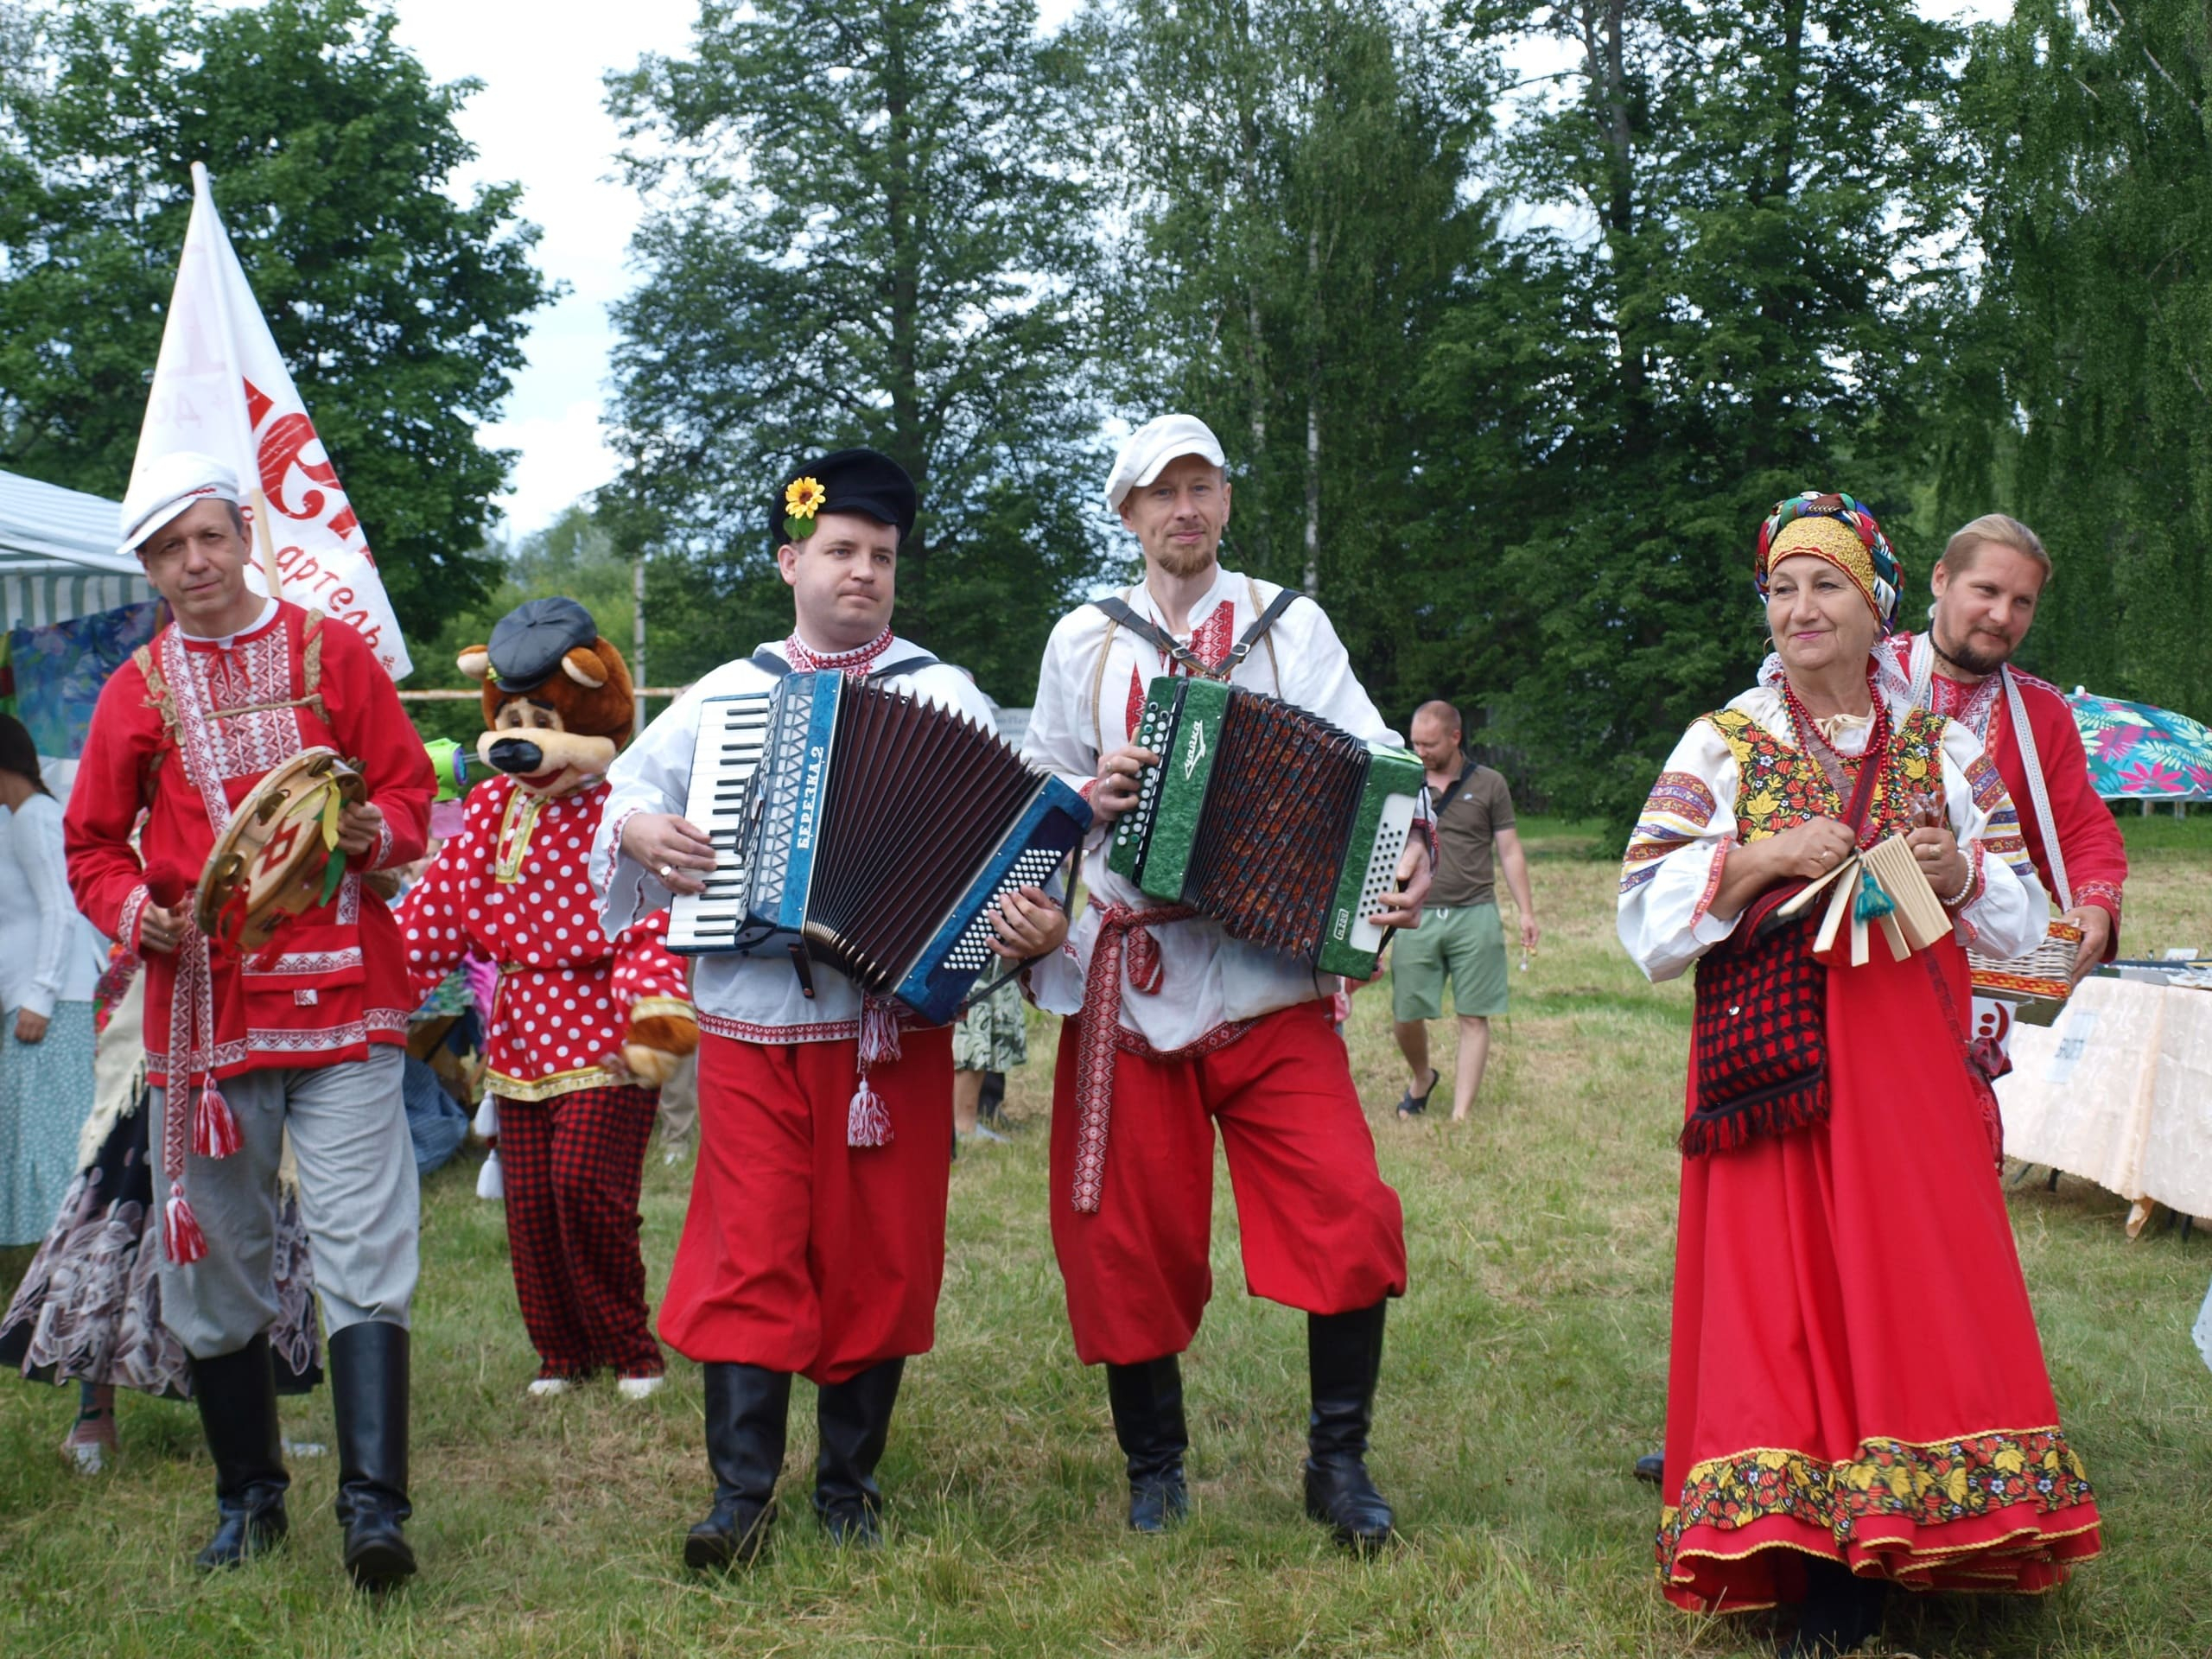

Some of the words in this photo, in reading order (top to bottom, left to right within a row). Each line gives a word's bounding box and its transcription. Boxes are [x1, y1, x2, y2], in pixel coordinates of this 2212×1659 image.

[276, 546, 381, 649] артель
[798, 764, 819, 849] БЕРЕЗКА
[810, 747, 823, 758] 2
